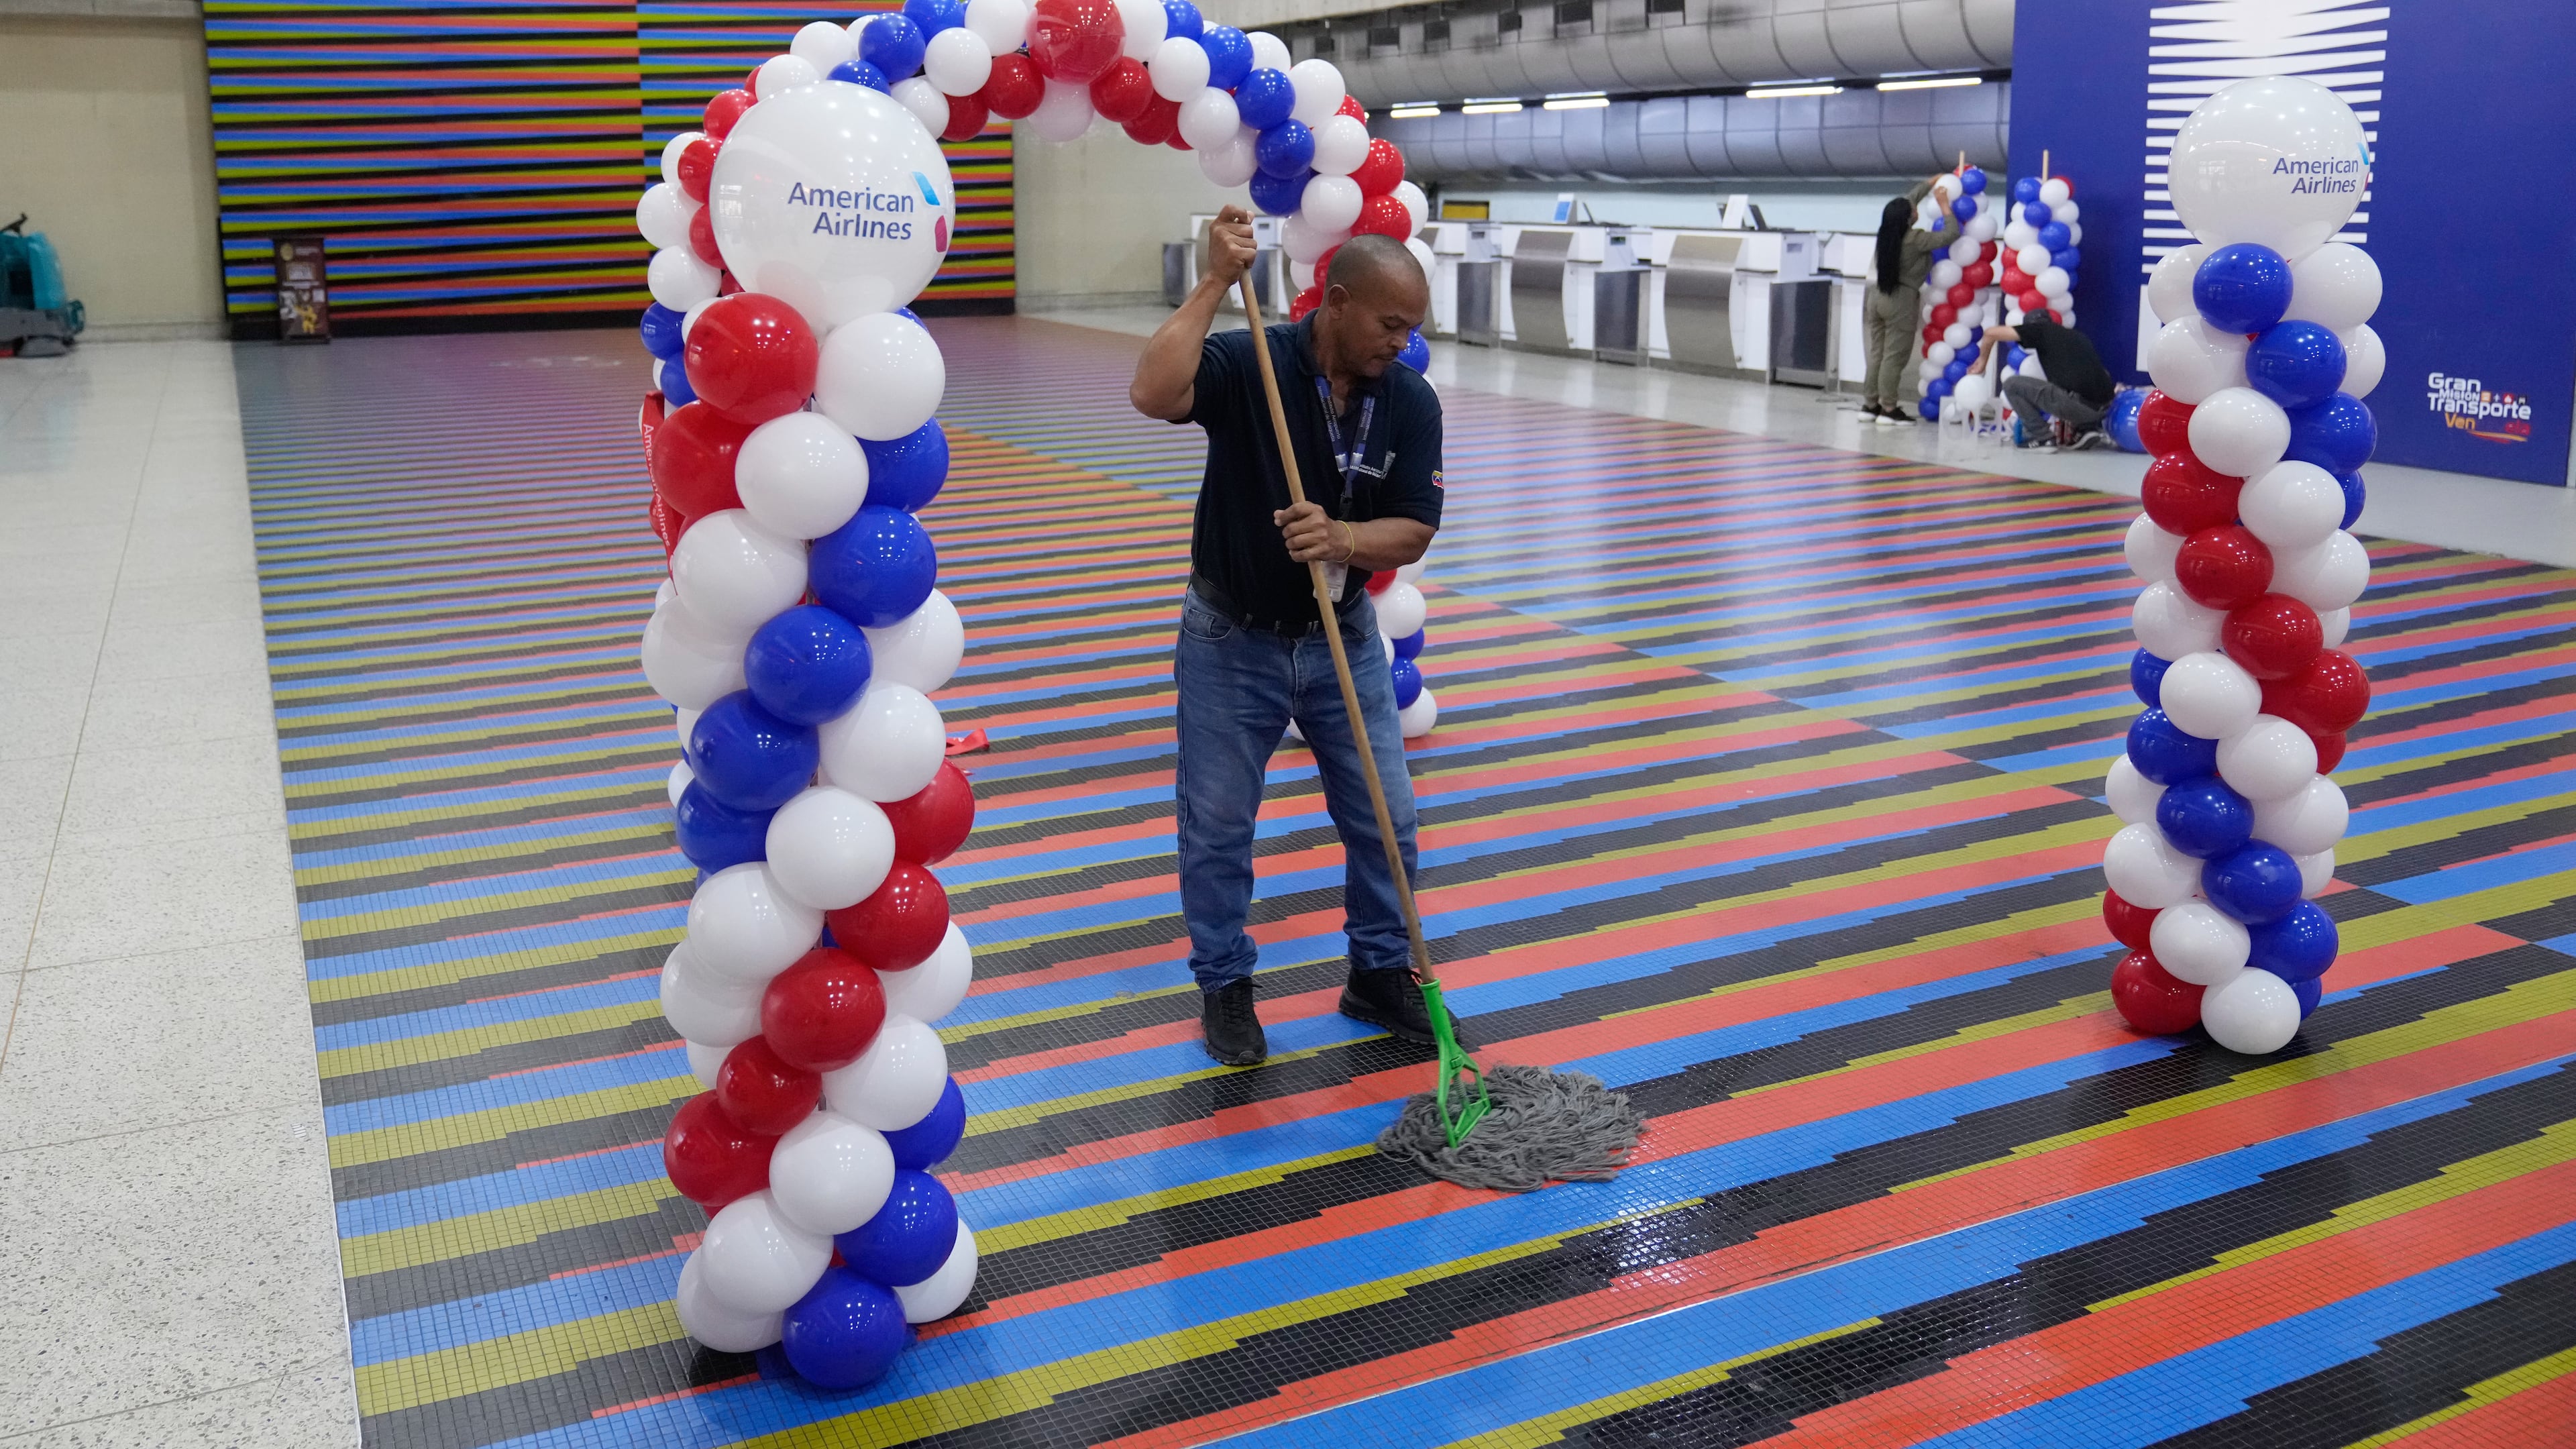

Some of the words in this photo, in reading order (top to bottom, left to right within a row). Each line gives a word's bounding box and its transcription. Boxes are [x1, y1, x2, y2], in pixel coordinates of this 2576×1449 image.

[2272, 156, 2359, 174] American
[2291, 176, 2357, 194] Airlines
[787, 182, 914, 213] American
[812, 211, 912, 240] Airlines
[2428, 372, 2481, 393] Gran
[2427, 392, 2532, 420] Transporte
[2445, 412, 2476, 430] Ven
